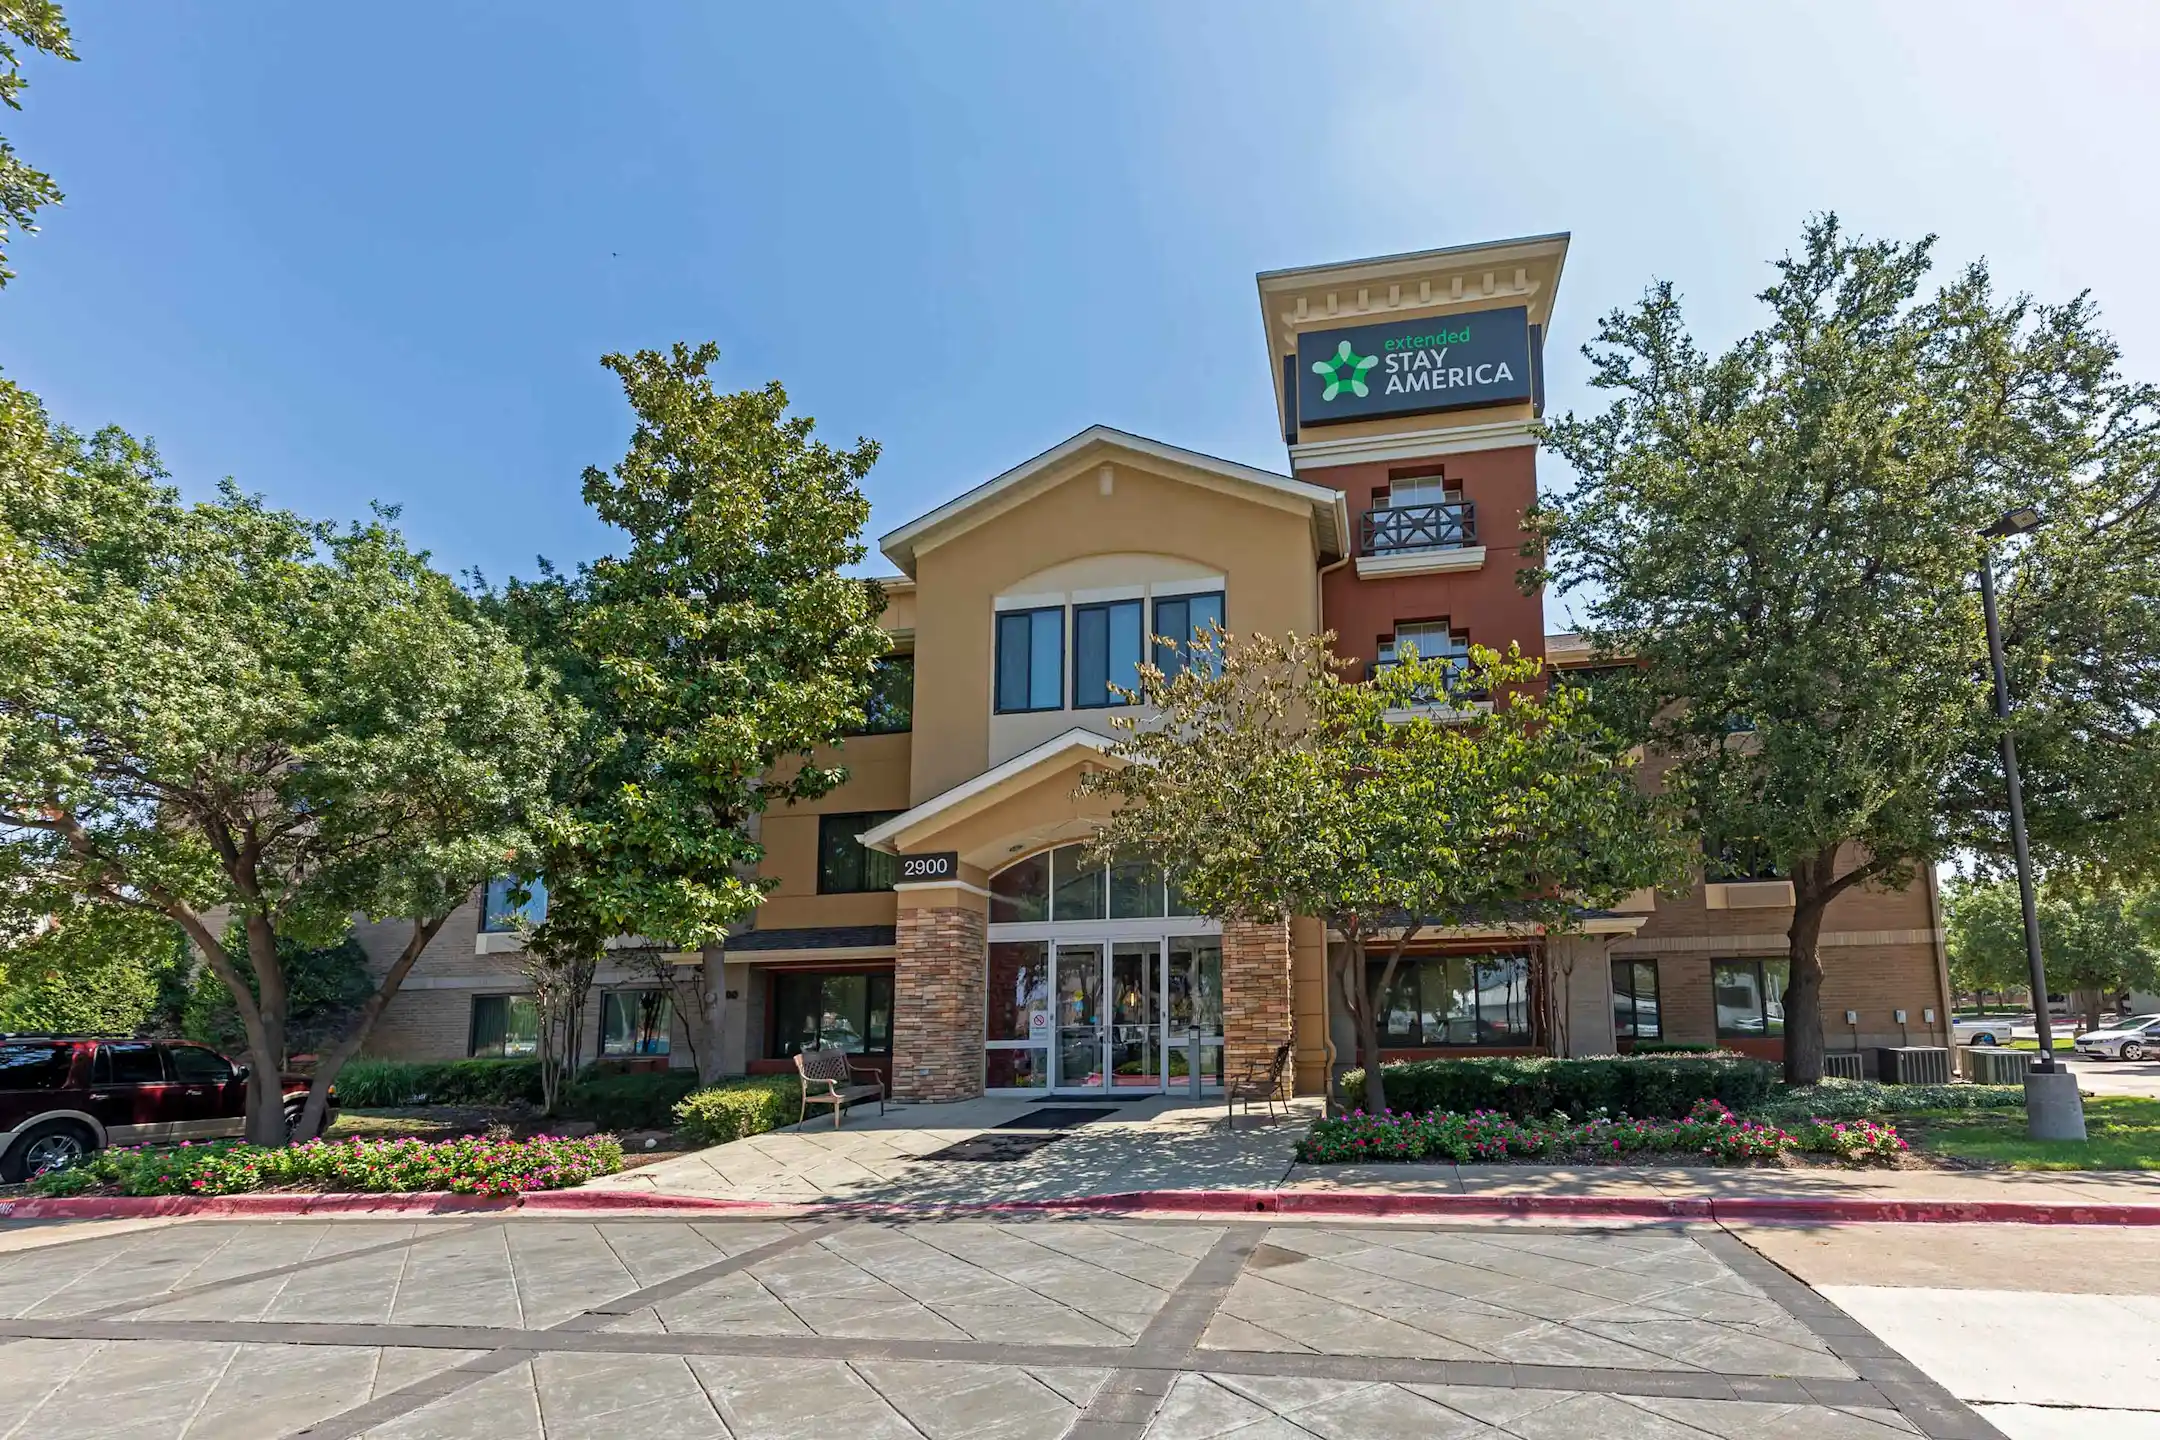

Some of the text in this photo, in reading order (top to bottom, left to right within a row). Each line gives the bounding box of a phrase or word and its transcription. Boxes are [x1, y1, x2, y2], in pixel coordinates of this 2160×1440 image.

[1384, 326, 1471, 351] extended
[1385, 347, 1449, 374] STAY
[1385, 362, 1514, 395] AMERICA
[904, 858, 948, 876] 2900
